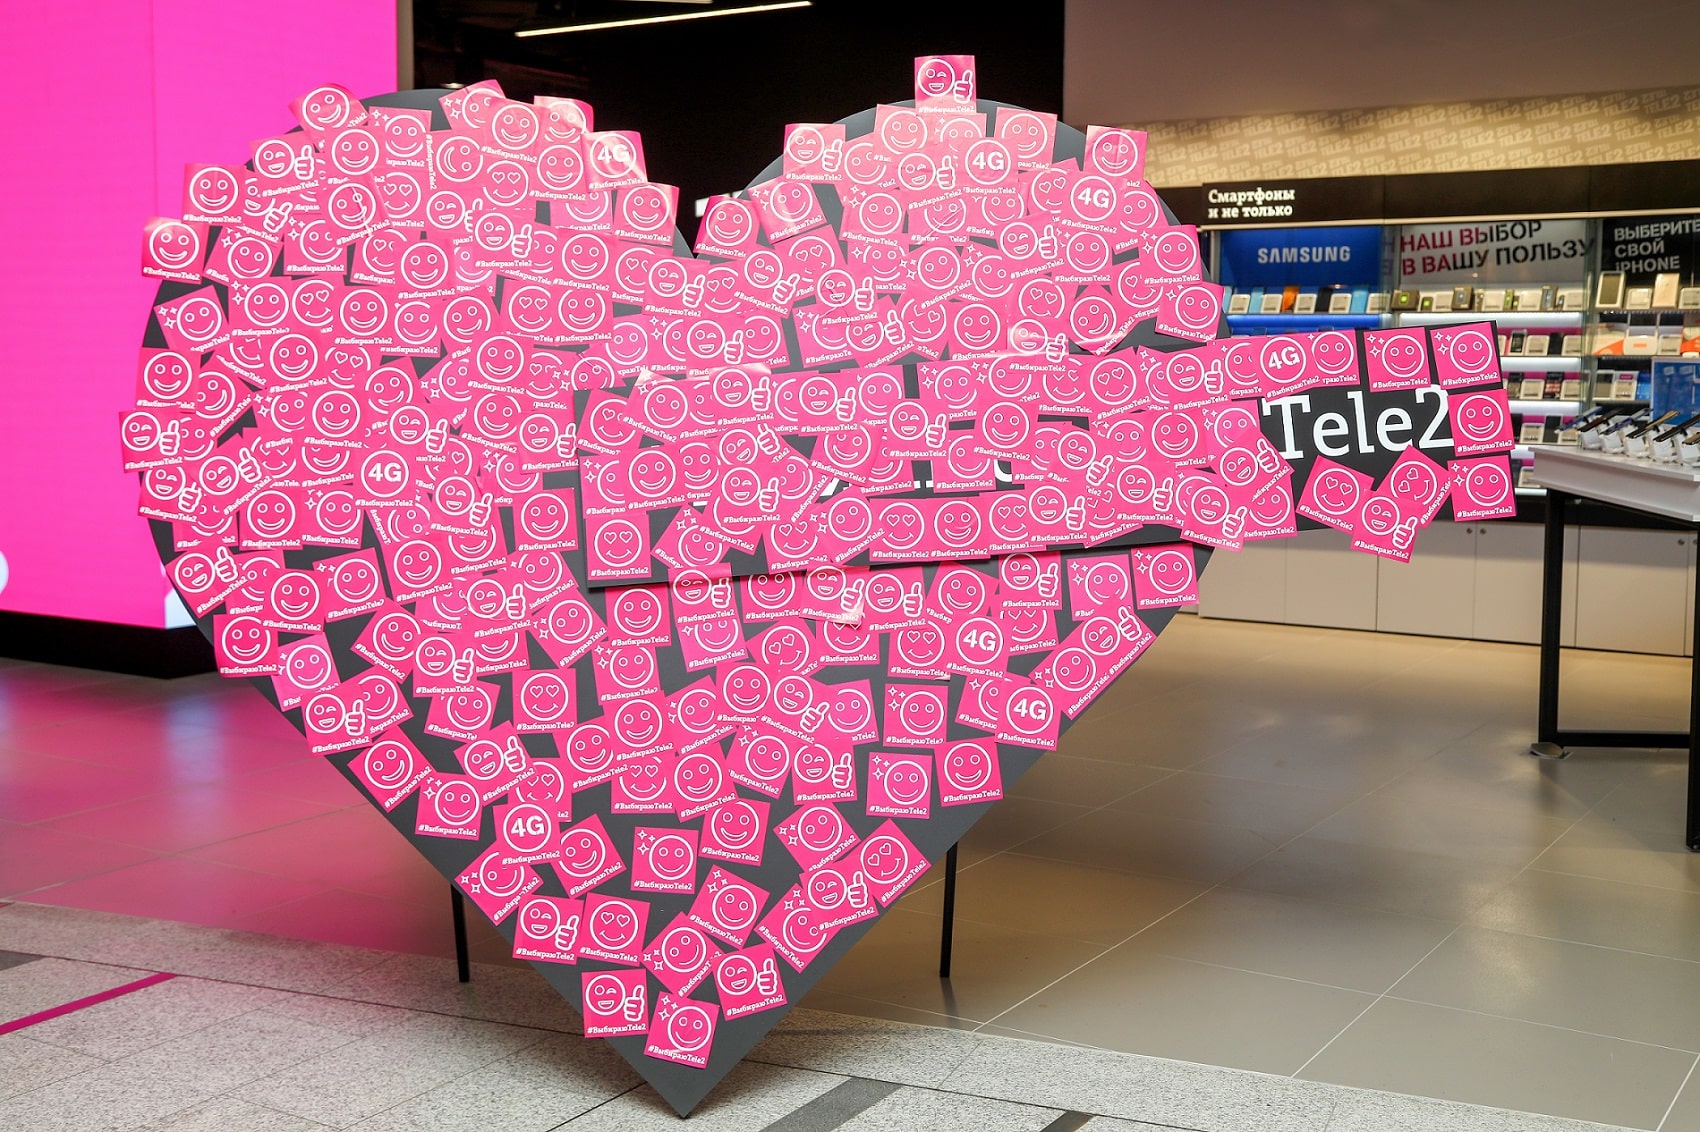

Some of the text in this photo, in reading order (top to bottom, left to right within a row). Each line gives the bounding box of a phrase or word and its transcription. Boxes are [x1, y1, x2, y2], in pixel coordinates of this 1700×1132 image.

[481, 146, 538, 162] #ВыбираюTele2
[598, 144, 630, 163] 4G
[972, 151, 1004, 170] 4G
[426, 134, 436, 190] #ВыбираюTele2
[786, 172, 842, 180] #ВыбираюTele2
[262, 180, 319, 198] #ВыбираюTele2
[530, 190, 586, 200] #ВыбираюTele2
[1208, 187, 1295, 206] Смартфоны
[908, 189, 961, 210] #ВыбираюTele2
[1078, 187, 1110, 208] 4G
[183, 214, 242, 223] #ВыбираюTele2
[1208, 205, 1293, 218] и не только
[1062, 218, 1117, 234] #ВыбираюTele2
[1614, 219, 1700, 242] ВЫБЕРИТЕ
[615, 229, 671, 241] #ВыбираюTele2
[842, 230, 898, 246] #ВыбираюTele2
[1401, 220, 1542, 252] НАШ ВЫБОР
[1258, 246, 1351, 264] SAMSUNG
[1614, 238, 1665, 258] СВОЙ
[475, 260, 532, 268] #ВыбираюTele2
[1402, 238, 1595, 276] В ВАШУ ПОЛЬЗУ
[143, 266, 200, 280] #ВыбираюTele2
[286, 264, 344, 272] #ВыбираюTele2
[1010, 259, 1064, 279] #ВыбираюTele2
[552, 278, 610, 292] #ВыбираюTele2
[1055, 274, 1110, 282] #ВыбираюTele2
[1144, 274, 1200, 284] #ВыбираюTele2
[398, 288, 455, 299] #ВыбираюTele2
[921, 280, 972, 308] #ВыбираюTele2
[734, 291, 789, 314] #ВыбираюTele2
[644, 304, 702, 318] #ВыбираюTele2
[334, 337, 392, 345] #ВыбираюTele2
[555, 332, 612, 342] #ВыбираюTele2
[1268, 346, 1300, 370] 4G
[1010, 362, 1066, 372] #ВыбираюTele2
[468, 380, 524, 394] #ВыбираюTele2
[1266, 376, 1320, 398] #ВыбираюTele2
[1372, 377, 1428, 389] #ВыбираюTele2
[1098, 396, 1150, 419] #ВыбираюTele2
[1173, 394, 1228, 410] #ВыбираюTele2
[718, 412, 774, 425] #ВыбираюTele2
[1262, 385, 1454, 461] Tele2
[622, 416, 677, 442] #ВыбираюTele2
[800, 423, 858, 432] #ВыбираюTele2
[304, 436, 362, 449] #ВыбираюTele2
[461, 432, 518, 454] #ВыбираюTele2
[1457, 440, 1512, 452] #ВыбираюTele2
[890, 450, 946, 458] #ВыбираюTele2
[973, 446, 1030, 461] #ВыбираюTele2
[124, 456, 183, 470] #ВыбираюTele2
[522, 460, 579, 470] #ВыбираюTele2
[369, 464, 402, 481] 4G
[811, 460, 866, 483] #ВыбираюTele2
[936, 480, 993, 490] #ВыбираюTele2
[223, 476, 272, 515] #ВыбираюTele2
[628, 494, 685, 510] #ВыбираюTele2
[790, 474, 828, 523] #ВыбираюTele2
[140, 506, 197, 522] #ВыбираюTele2
[1117, 513, 1174, 522] #ВыбираюTele2
[1300, 504, 1354, 530] #ВыбираюTele2
[1457, 506, 1512, 518] #ВыбираюTele2
[430, 524, 488, 536] #ВыбираюTele2
[1031, 532, 1088, 542] #ВыбираюTele2
[302, 535, 359, 544] #ВыбираюTele2
[518, 540, 576, 550] #ВыбираюTele2
[700, 526, 754, 551] #ВыбираюTele2
[835, 528, 885, 562] #ВыбираюTele2
[1184, 530, 1240, 548] #ВыбираюTele2
[872, 550, 930, 558] #ВыбираюTele2
[931, 548, 988, 558] #ВыбираюTele2
[1354, 540, 1408, 558] #ВыбираюTele2
[450, 557, 506, 574] #ВыбираюTele2
[591, 567, 648, 576] #ВыбираюTele2
[196, 576, 248, 612] #ВыбираюTele2
[396, 582, 453, 602] #ВыбираюTele2
[1140, 594, 1196, 605] #ВыбираюTele2
[1002, 600, 1058, 608] #ВыбираюTele2
[678, 608, 734, 624] #ВыбираюTele2
[262, 620, 322, 631] #ВыбираюTele2
[474, 620, 531, 638] #ВыбираюTele2
[869, 618, 926, 632] #ВыбираюTele2
[560, 628, 607, 666] #ВыбираюTele2
[611, 636, 669, 646] #ВыбираюTele2
[963, 629, 996, 652] 4G
[688, 649, 745, 668] #ВыбираюTele2
[820, 654, 877, 662] #ВыбираюTele2
[1109, 633, 1152, 674] #ВыбираюTele2
[220, 664, 277, 673] #ВыбираюTele2
[946, 662, 1003, 676] #ВыбираюTele2
[416, 686, 474, 694] #ВыбираюTele2
[1014, 698, 1046, 720] 4G
[312, 736, 370, 753] #ВыбираюTele2
[998, 733, 1054, 747] #ВыбираюTele2
[616, 742, 674, 760] #ВыбираюTele2
[572, 764, 628, 788] #ВыбираюTele2
[384, 766, 432, 808] #ВыбираюTele2
[943, 788, 1000, 802] #ВыбираюTele2
[796, 790, 855, 801] #ВыбираюTele2
[614, 802, 672, 810] #ВыбираюTele2
[680, 792, 736, 818] #ВыбираюTele2
[870, 805, 928, 815] #ВыбираюTele2
[418, 824, 477, 836] #ВыбираюTele2
[511, 815, 544, 836] 4G
[502, 850, 560, 864] #ВыбираюTele2
[701, 846, 759, 862] #ВыбираюTele2
[570, 861, 622, 896] #ВыбираюTele2
[634, 880, 692, 890] #ВыбираюTele2
[881, 860, 926, 902] #ВыбираюTele2
[819, 907, 874, 930] #ВыбираюTele2
[690, 914, 743, 945] #ВыбираюTele2
[516, 948, 574, 960] #ВыбираюTele2
[580, 946, 638, 962] #ВыбираюTele2
[758, 925, 804, 968] #ВыбираюTele2
[726, 994, 784, 1016] #ВыбираюTele2
[587, 1023, 646, 1034] #ВыбираюTele2
[648, 1045, 706, 1064] #ВыбираюTele2
